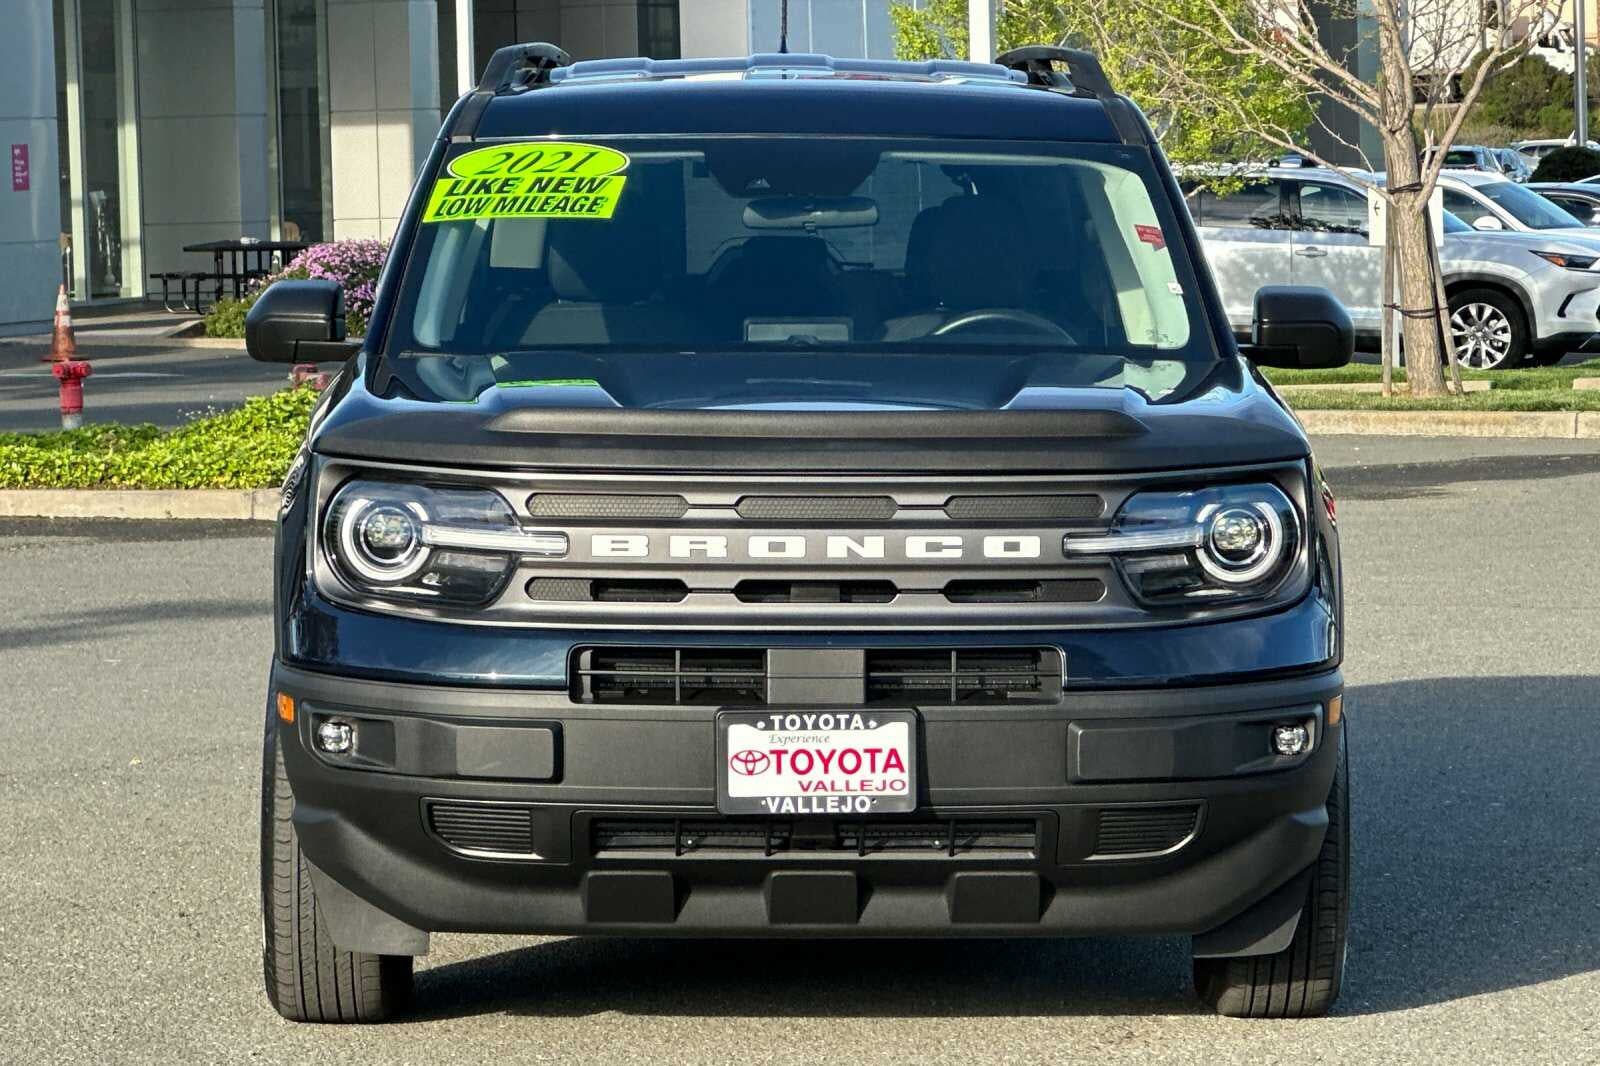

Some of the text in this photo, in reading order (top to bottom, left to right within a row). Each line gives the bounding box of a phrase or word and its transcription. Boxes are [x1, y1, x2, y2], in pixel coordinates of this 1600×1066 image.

[473, 150, 600, 175] 2021
[444, 176, 613, 197] LIKE NEW
[433, 195, 608, 217] LOW MILEAGE
[591, 535, 1041, 558] BRONCO
[770, 714, 865, 730] TOYOTA
[768, 734, 830, 746] Experience
[769, 748, 906, 775] TOYOTA
[798, 779, 906, 792] VALLEJO
[766, 796, 871, 813] VALLEJO
